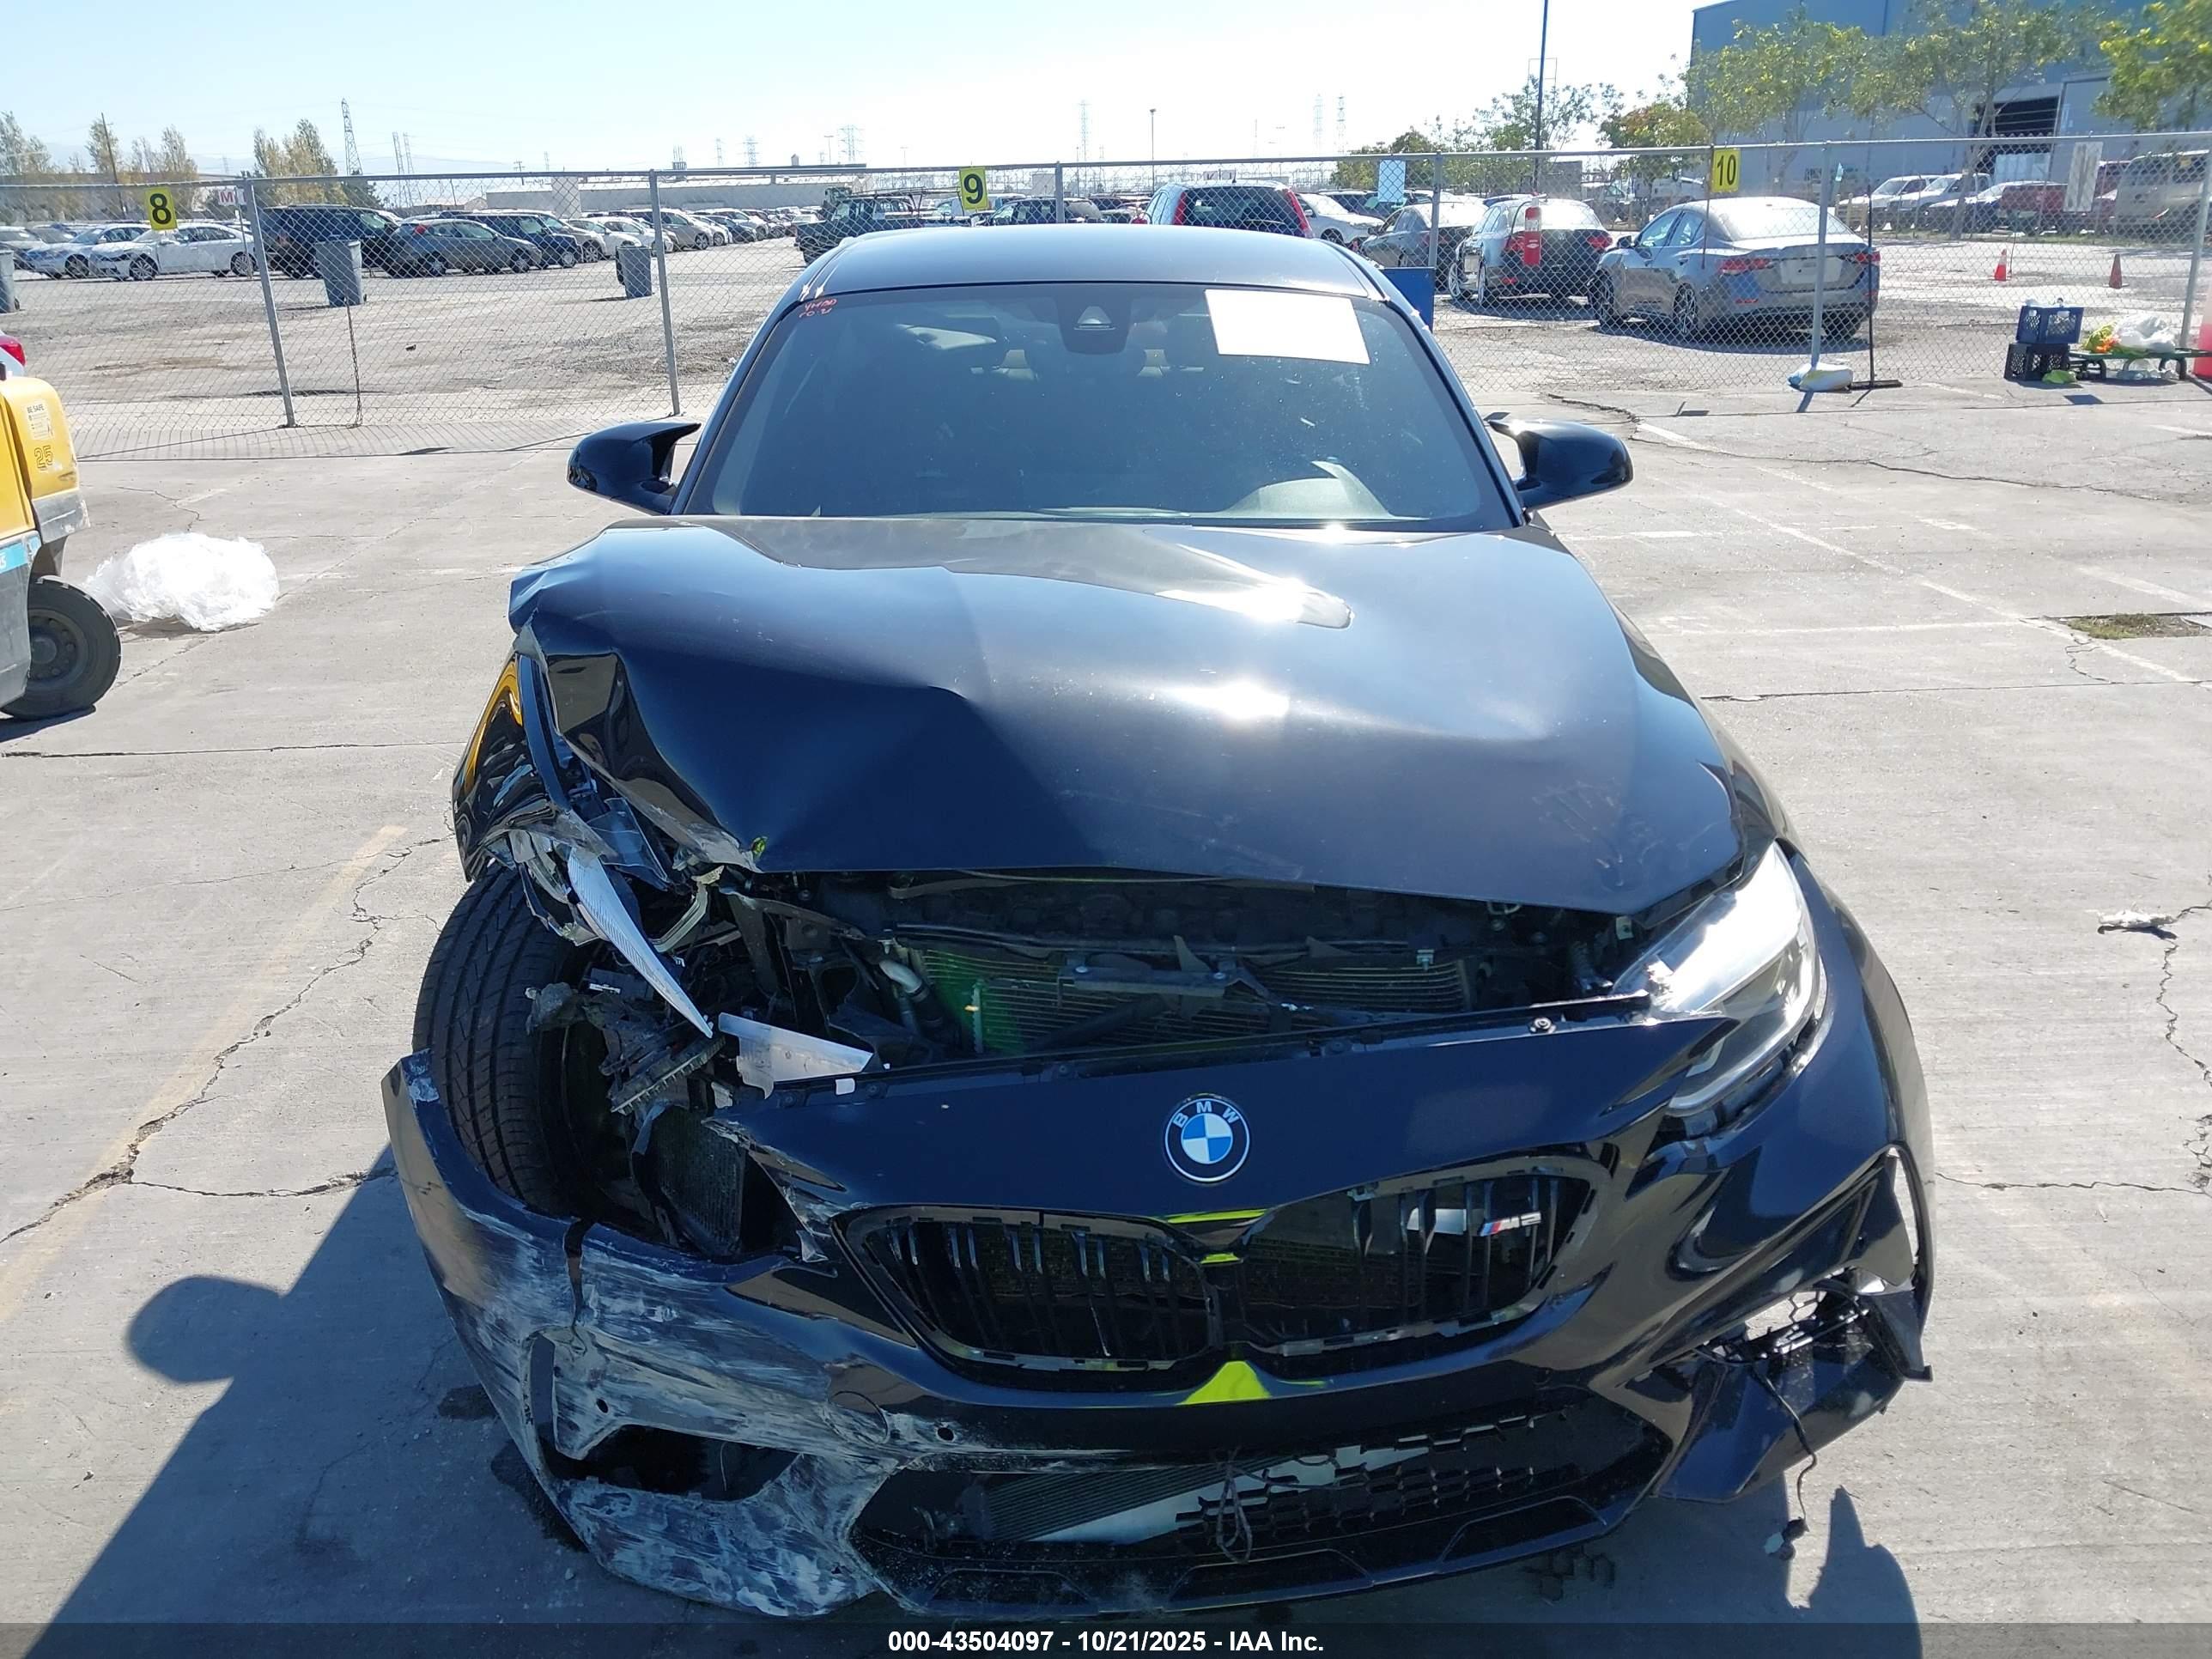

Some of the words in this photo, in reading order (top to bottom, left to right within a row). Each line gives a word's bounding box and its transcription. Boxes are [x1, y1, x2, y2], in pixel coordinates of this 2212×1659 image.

[1717, 154, 1737, 186] 10
[963, 173, 984, 204] 9
[149, 192, 173, 225] 8
[34, 445, 54, 470] 25
[1172, 1100, 1240, 1128] BMW
